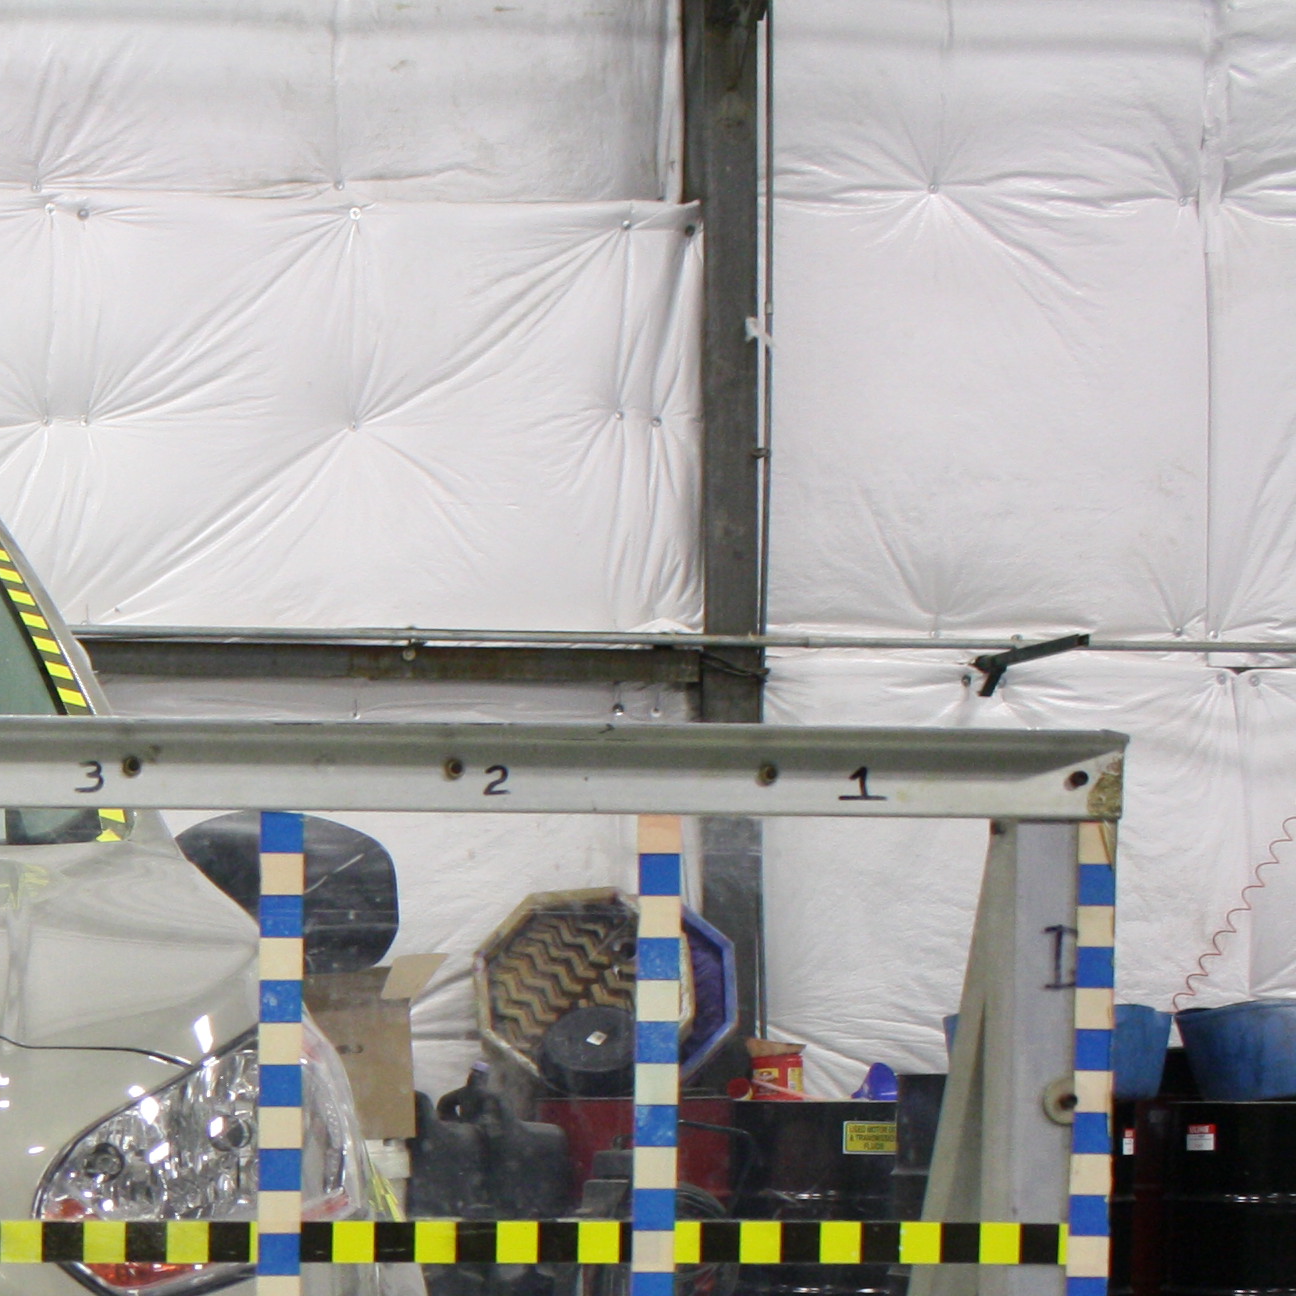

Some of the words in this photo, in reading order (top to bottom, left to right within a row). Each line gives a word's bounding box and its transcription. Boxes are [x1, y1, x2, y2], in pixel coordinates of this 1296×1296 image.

[74, 760, 105, 794] 3
[483, 764, 511, 796] 2
[838, 766, 888, 801] 1
